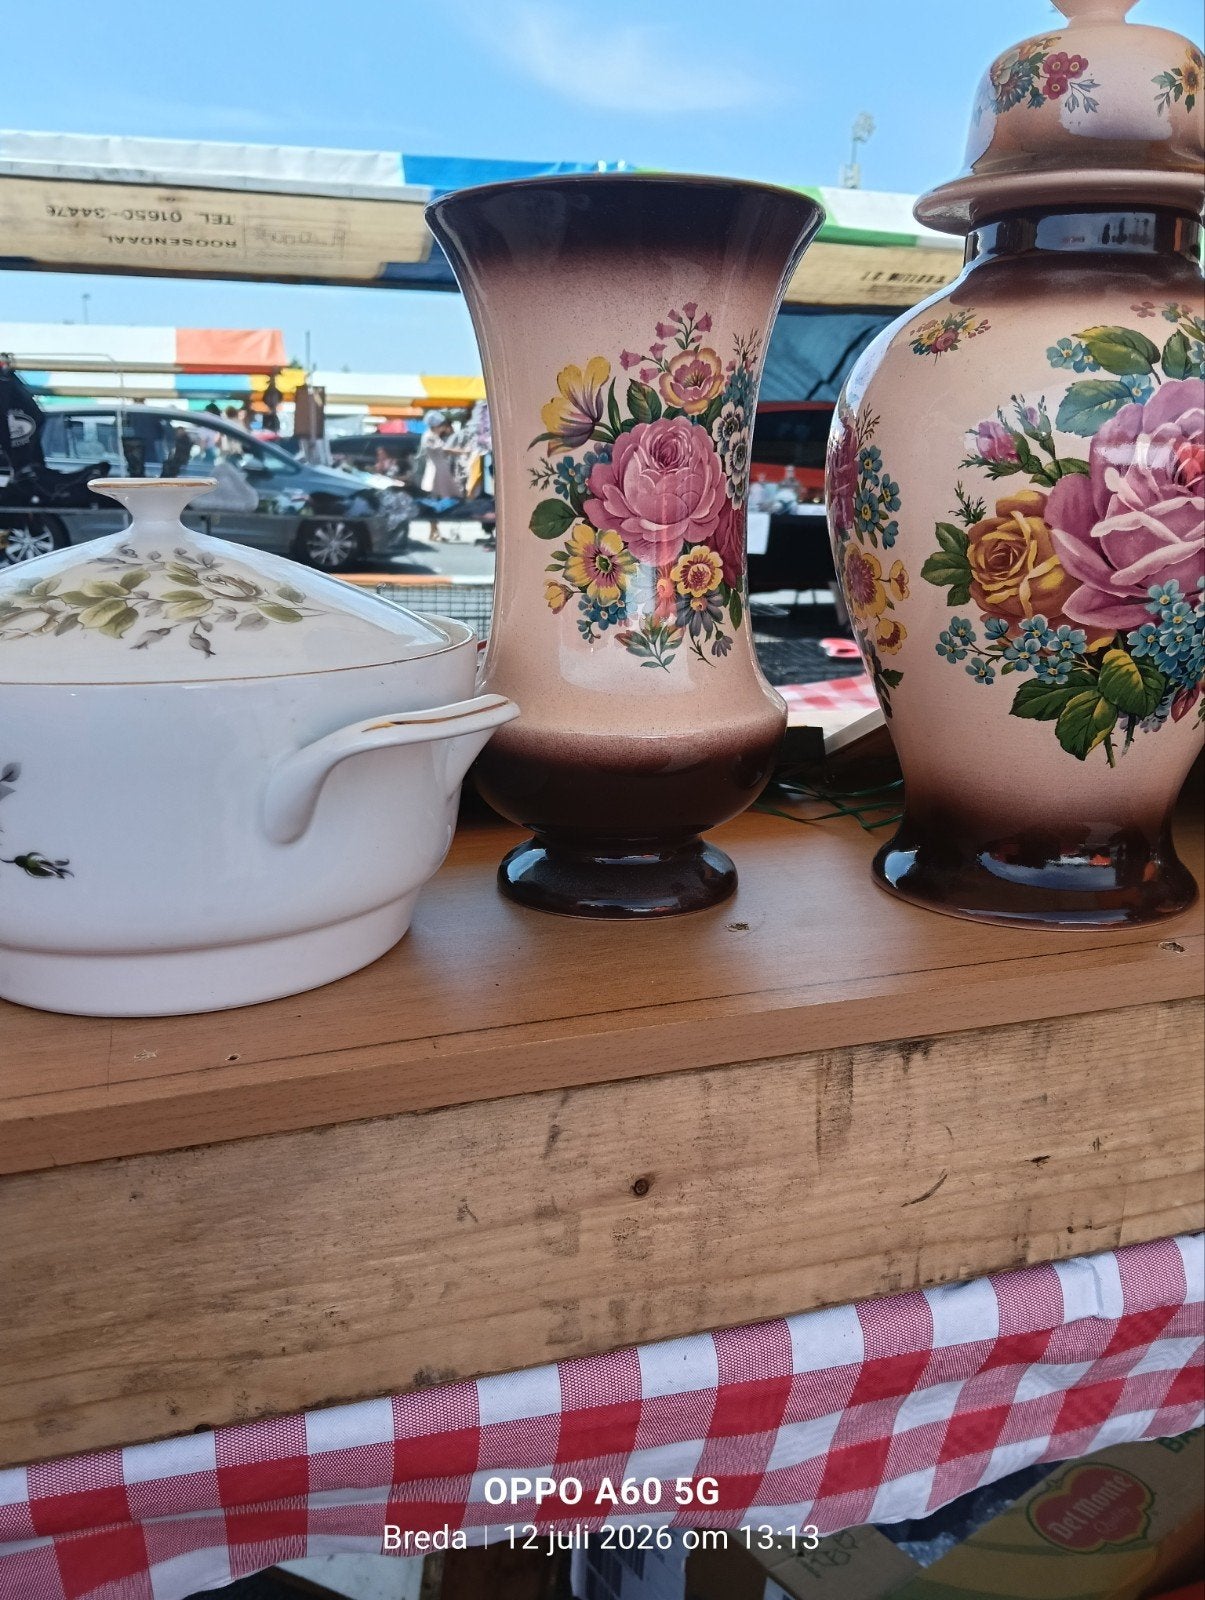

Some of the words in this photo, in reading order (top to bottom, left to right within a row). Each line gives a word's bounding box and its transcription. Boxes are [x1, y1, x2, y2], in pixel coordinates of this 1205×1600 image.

[102, 235, 238, 249] ROOSENDAAL
[1046, 1511, 1089, 1540] Del
[1072, 1475, 1133, 1519] Monte
